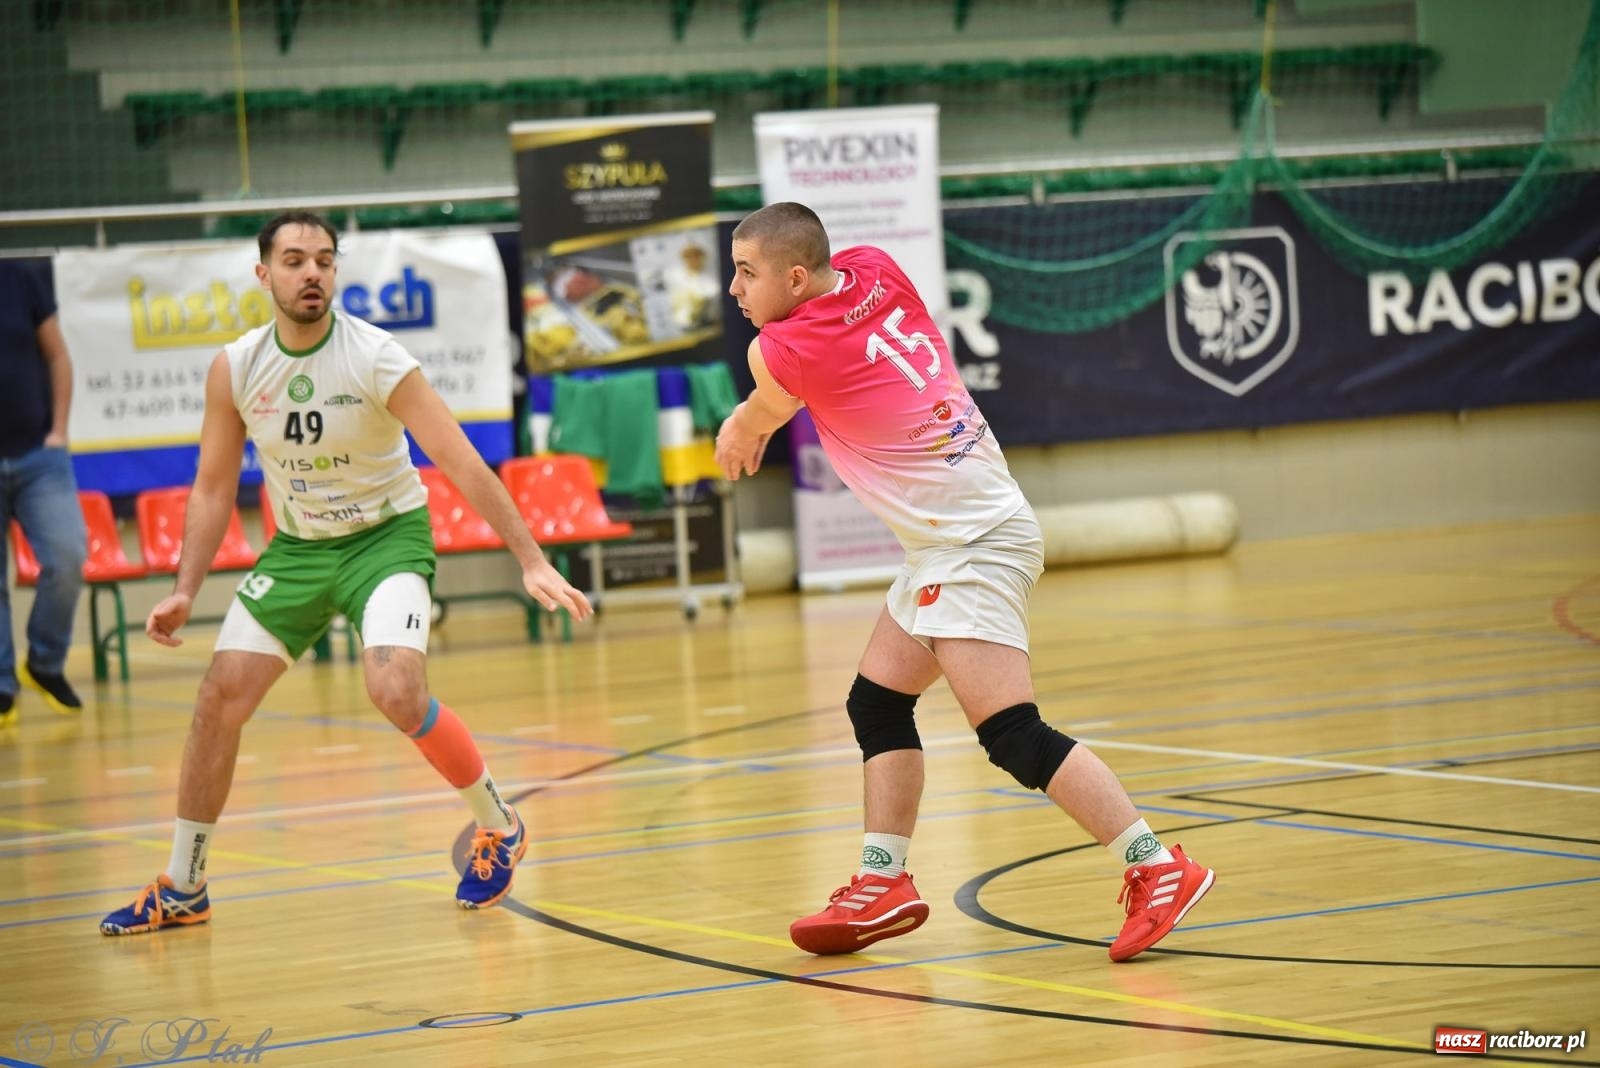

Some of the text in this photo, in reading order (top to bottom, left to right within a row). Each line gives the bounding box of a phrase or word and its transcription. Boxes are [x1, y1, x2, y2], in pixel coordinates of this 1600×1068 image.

[784, 132, 918, 164] PIVEXIN
[865, 305, 941, 394] 15
[284, 410, 324, 446] 49
